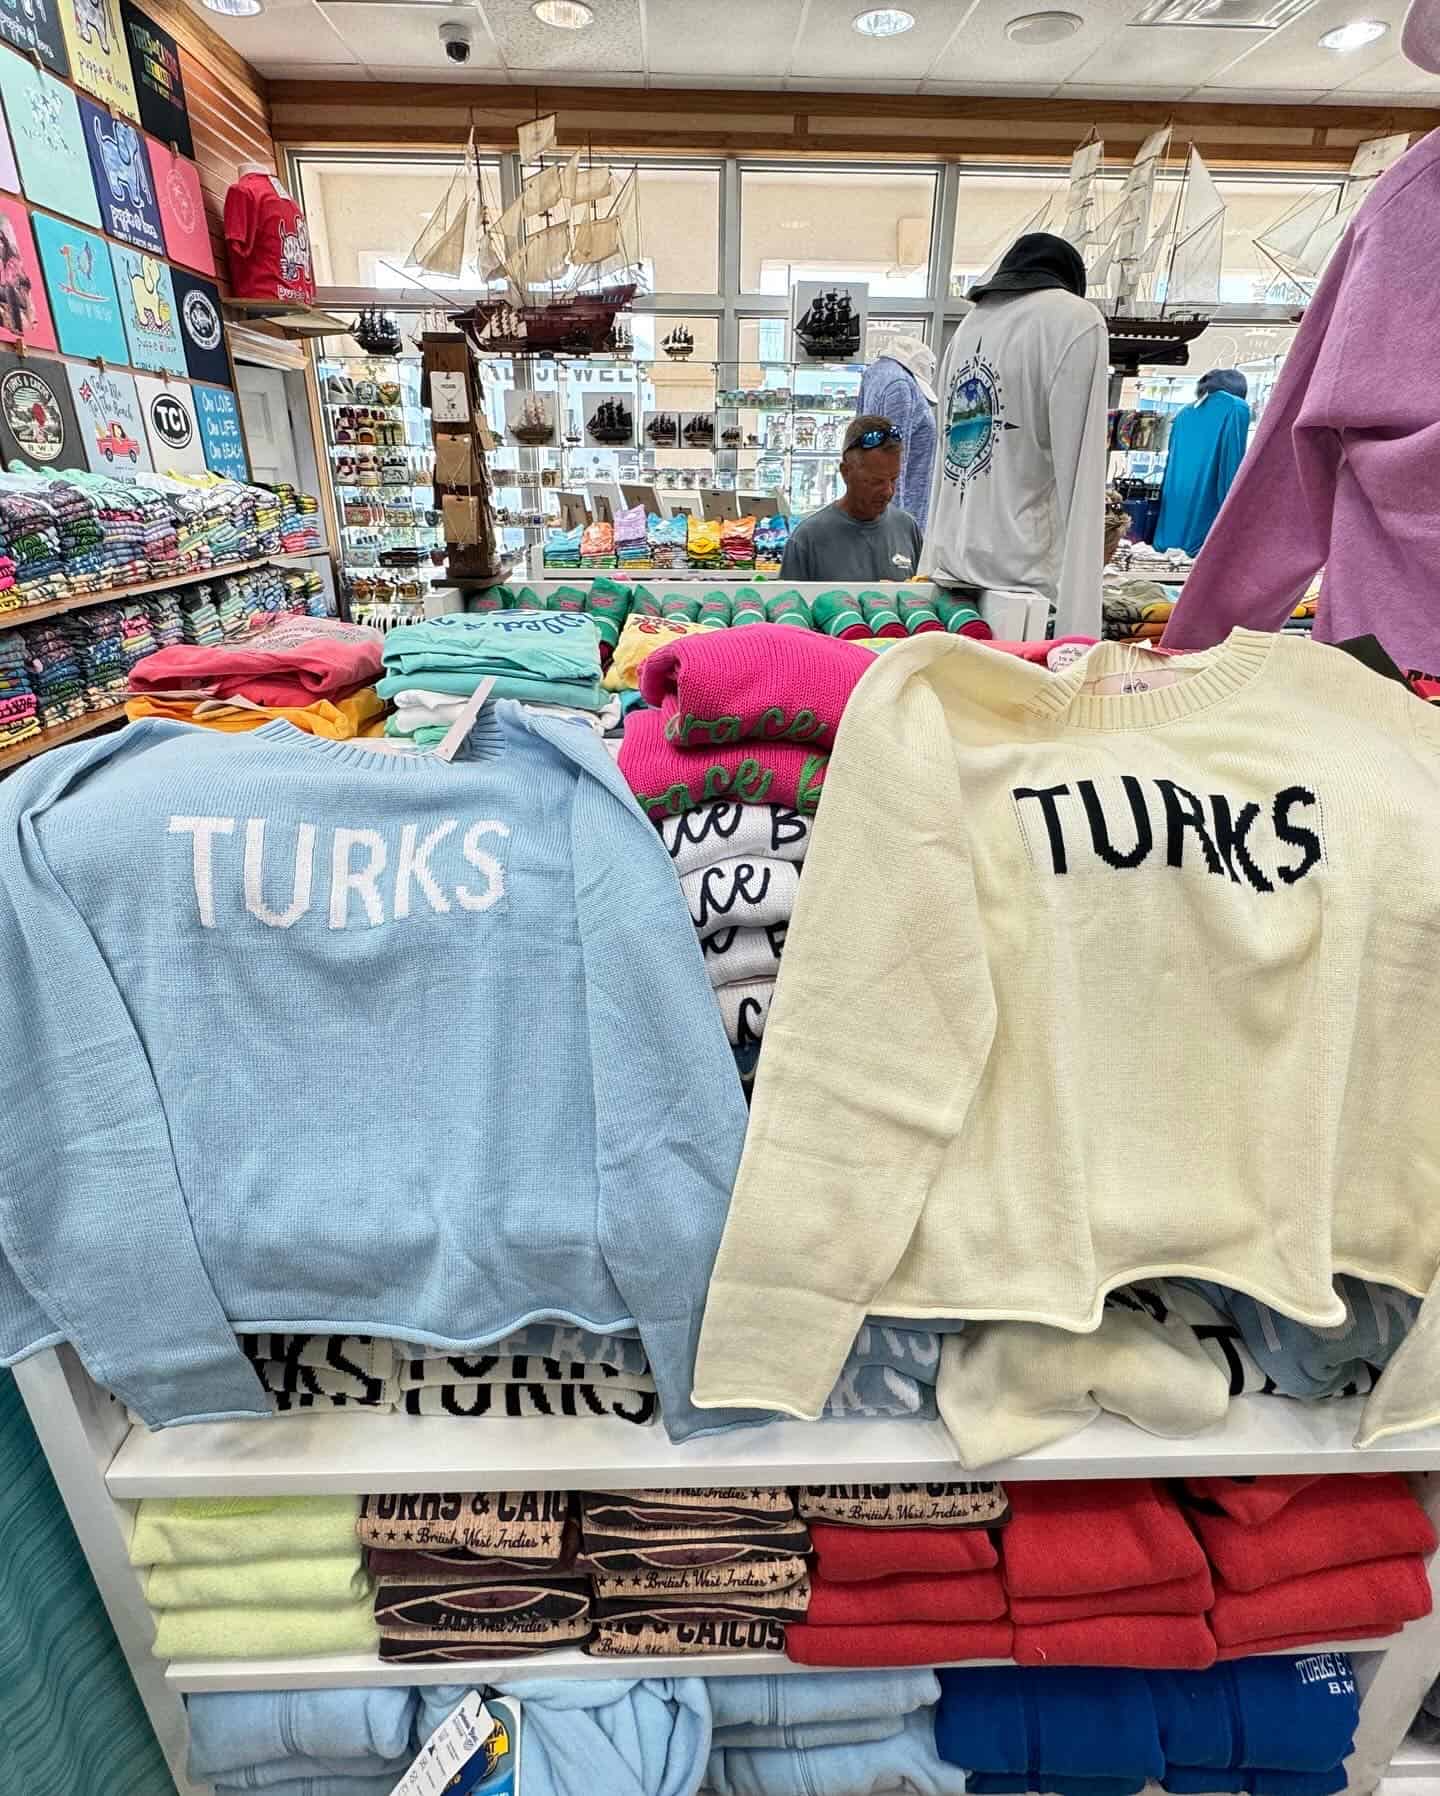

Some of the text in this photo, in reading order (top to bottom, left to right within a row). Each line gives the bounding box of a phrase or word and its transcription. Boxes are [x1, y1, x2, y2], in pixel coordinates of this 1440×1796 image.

[157, 405, 187, 432] TCI
[1012, 774, 1322, 893] TURKS
[167, 814, 512, 930] TURKS
[848, 1502, 969, 1521] British West Indies
[416, 1527, 538, 1549] British West Indies
[644, 1568, 768, 1589] British West Indies
[676, 1619, 785, 1651] CAICOS
[1295, 1653, 1337, 1685] TURKS
